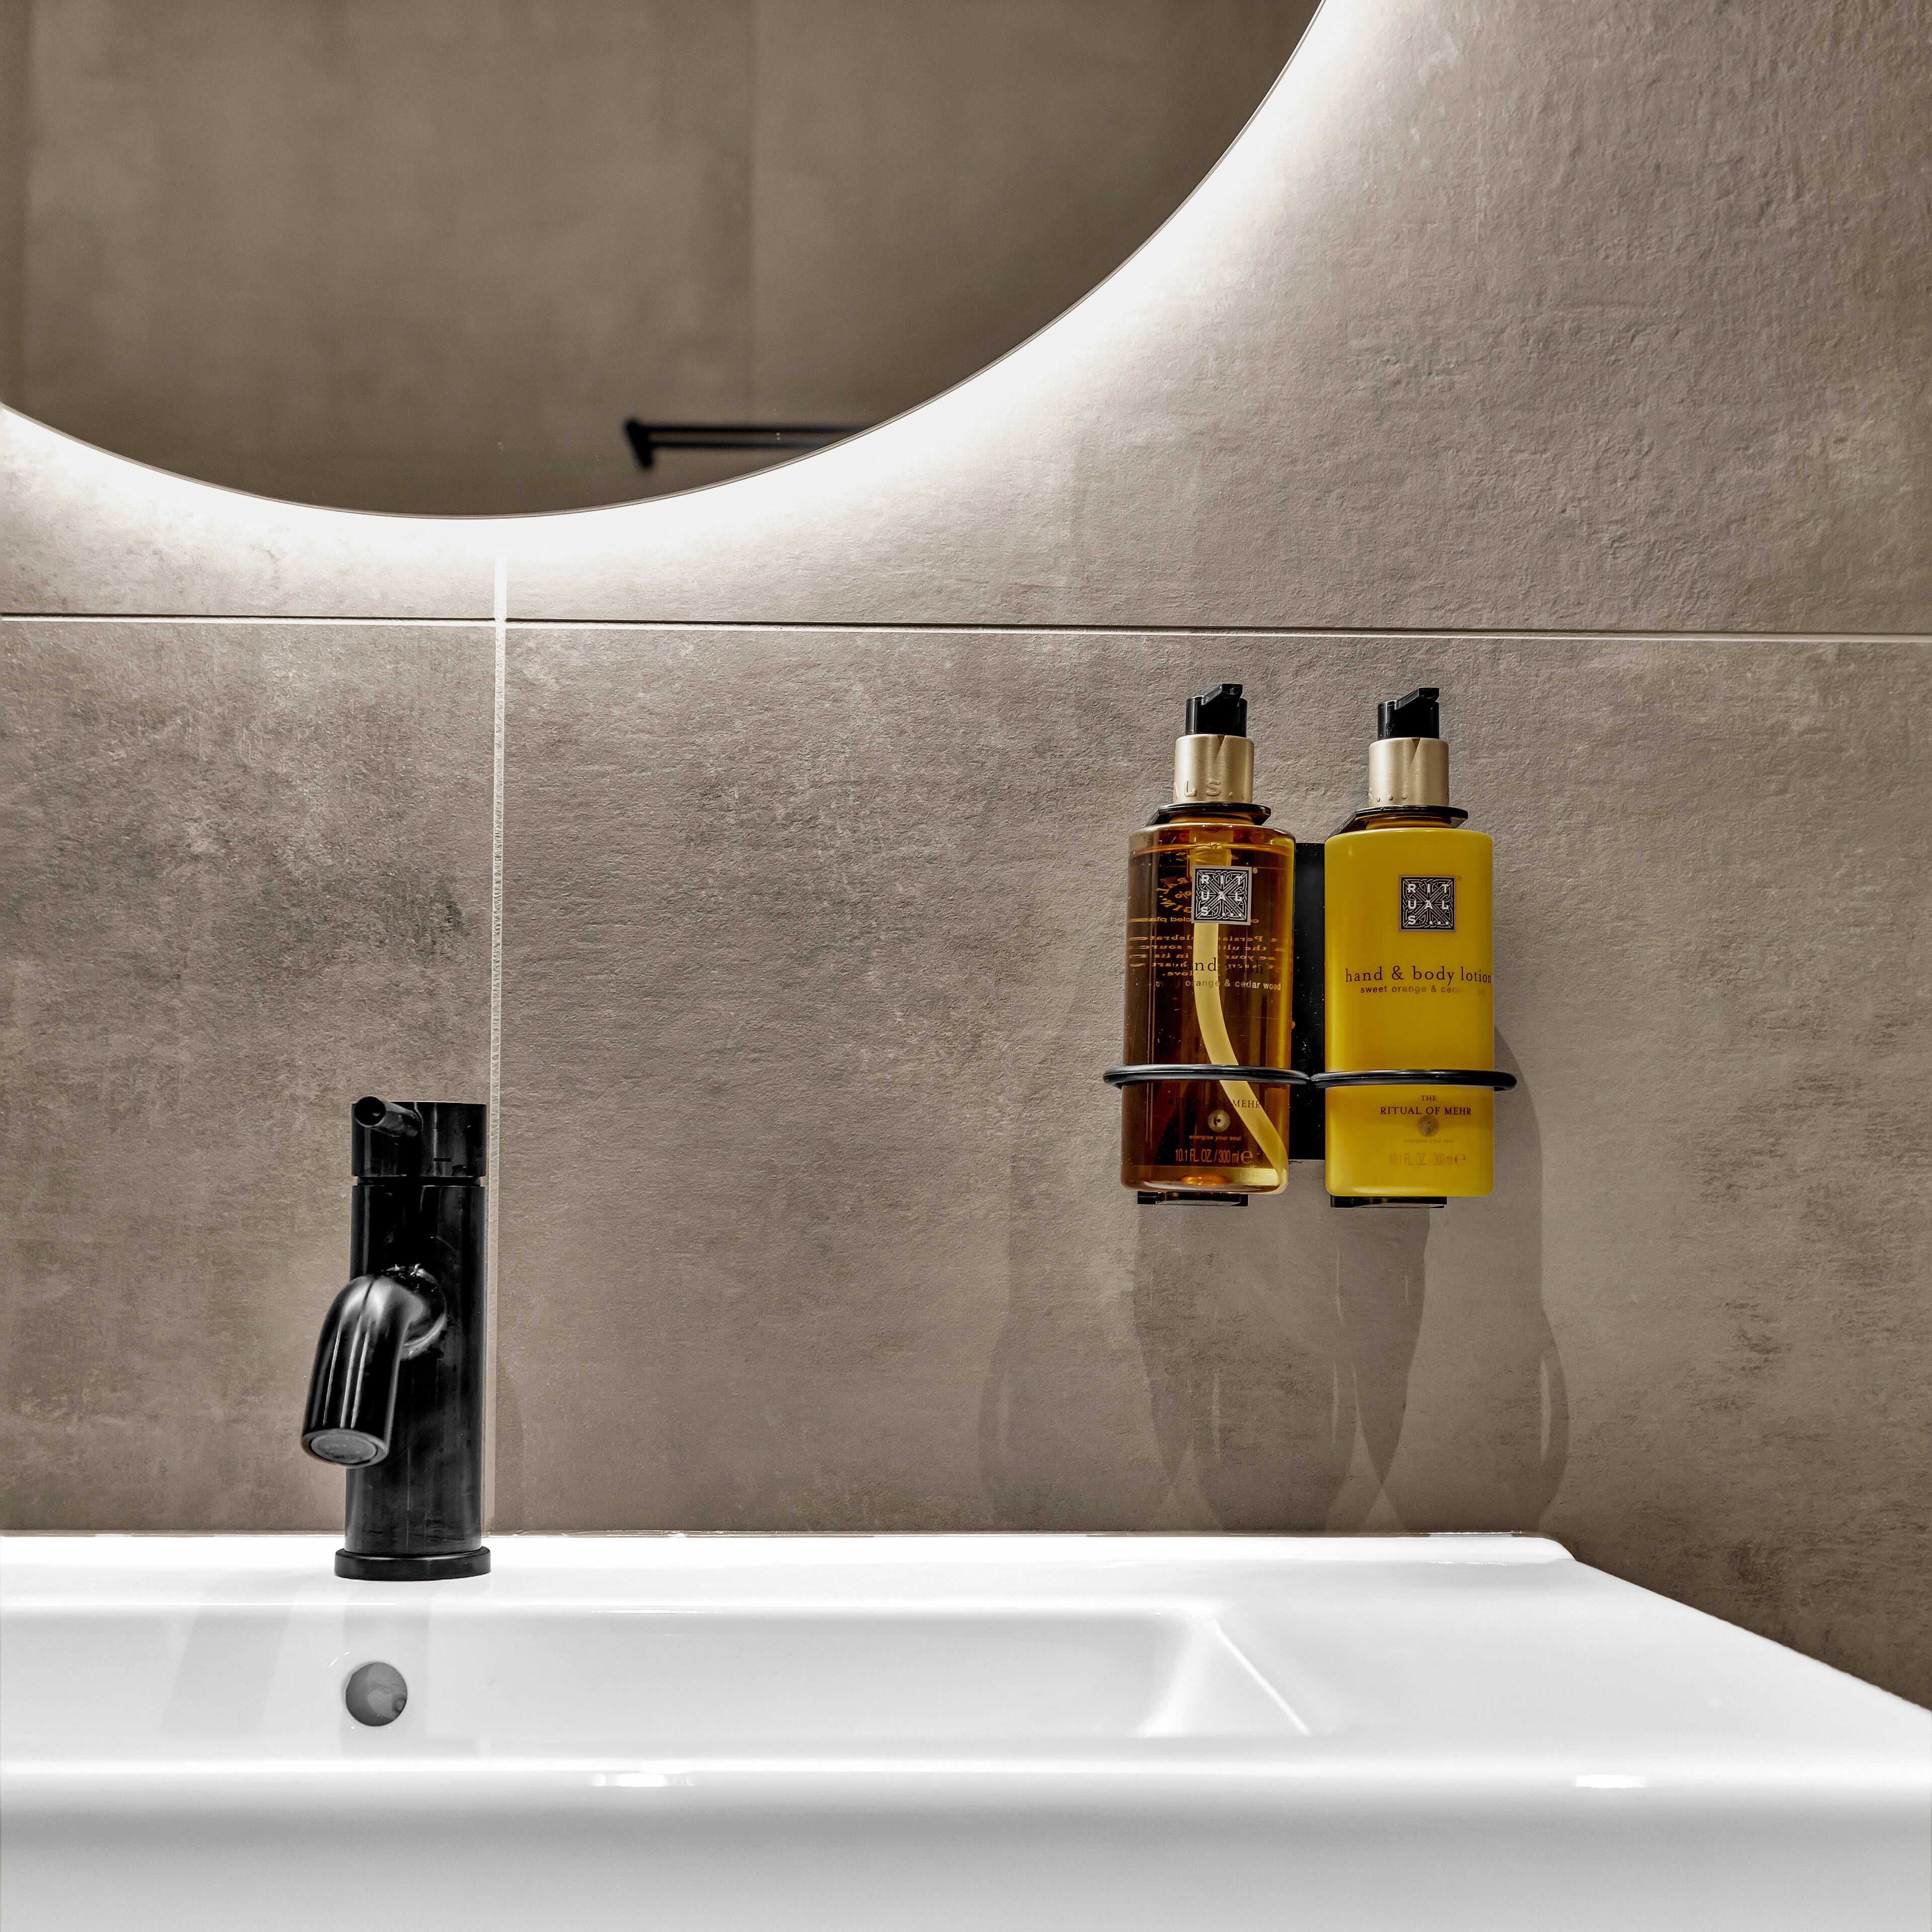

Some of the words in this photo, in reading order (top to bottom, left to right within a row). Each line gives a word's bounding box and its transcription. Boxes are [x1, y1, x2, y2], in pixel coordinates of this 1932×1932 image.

[1345, 965, 1383, 982] hand
[1391, 965, 1405, 981] &
[1411, 965, 1455, 986] body
[1460, 966, 1492, 984] lotion
[1224, 979, 1231, 987] &
[1234, 980, 1261, 989] cedar
[1263, 982, 1281, 991] wood
[1360, 985, 1387, 994] sweet
[1391, 985, 1426, 994] orange
[1430, 985, 1437, 993] &
[1233, 1099, 1262, 1108] MEHR
[1380, 1106, 1422, 1115] RITUAL
[1425, 1106, 1440, 1115] OF
[1444, 1107, 1472, 1115] MEHR
[1175, 1148, 1188, 1162] 10.1
[1218, 1149, 1231, 1163] 300
